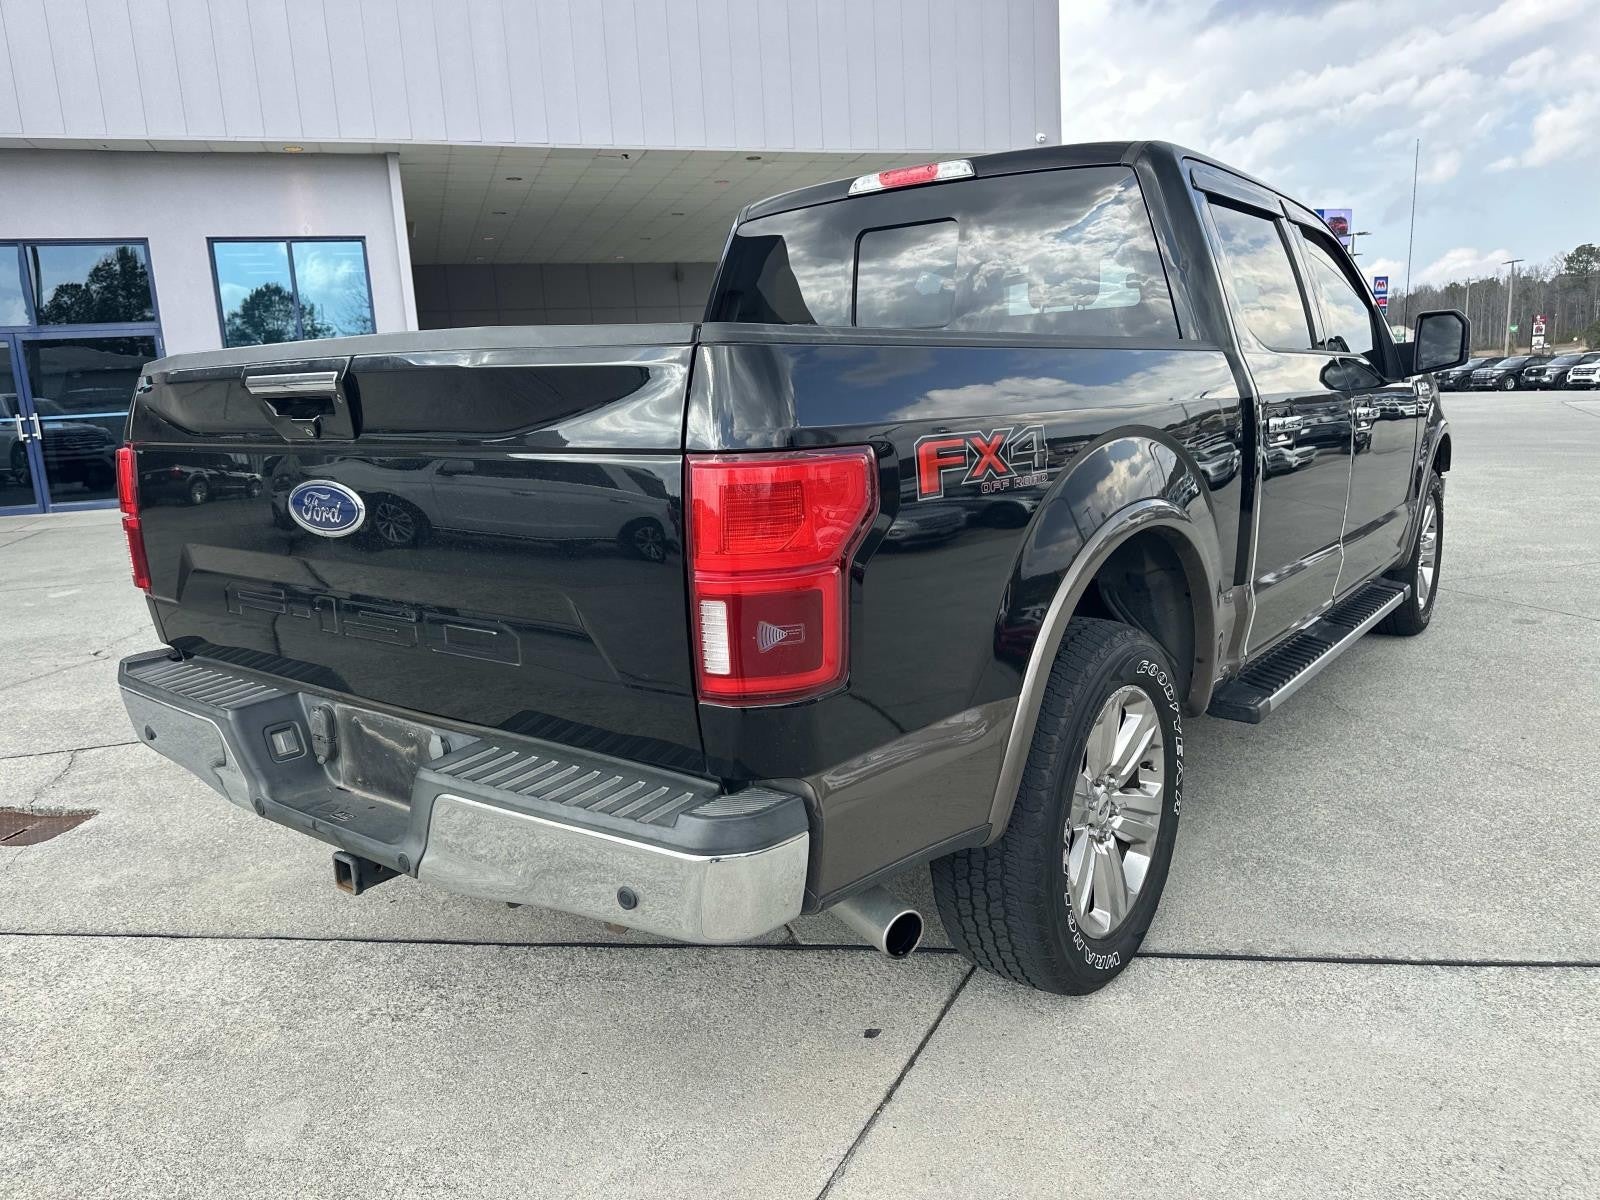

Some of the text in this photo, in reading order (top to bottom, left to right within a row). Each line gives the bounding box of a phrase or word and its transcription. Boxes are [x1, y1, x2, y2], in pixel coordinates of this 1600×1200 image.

[914, 424, 1048, 501] FX4
[981, 472, 1048, 494] OFF ROAD
[302, 491, 342, 523] Ford
[1136, 660, 1184, 816] GOODYEAR
